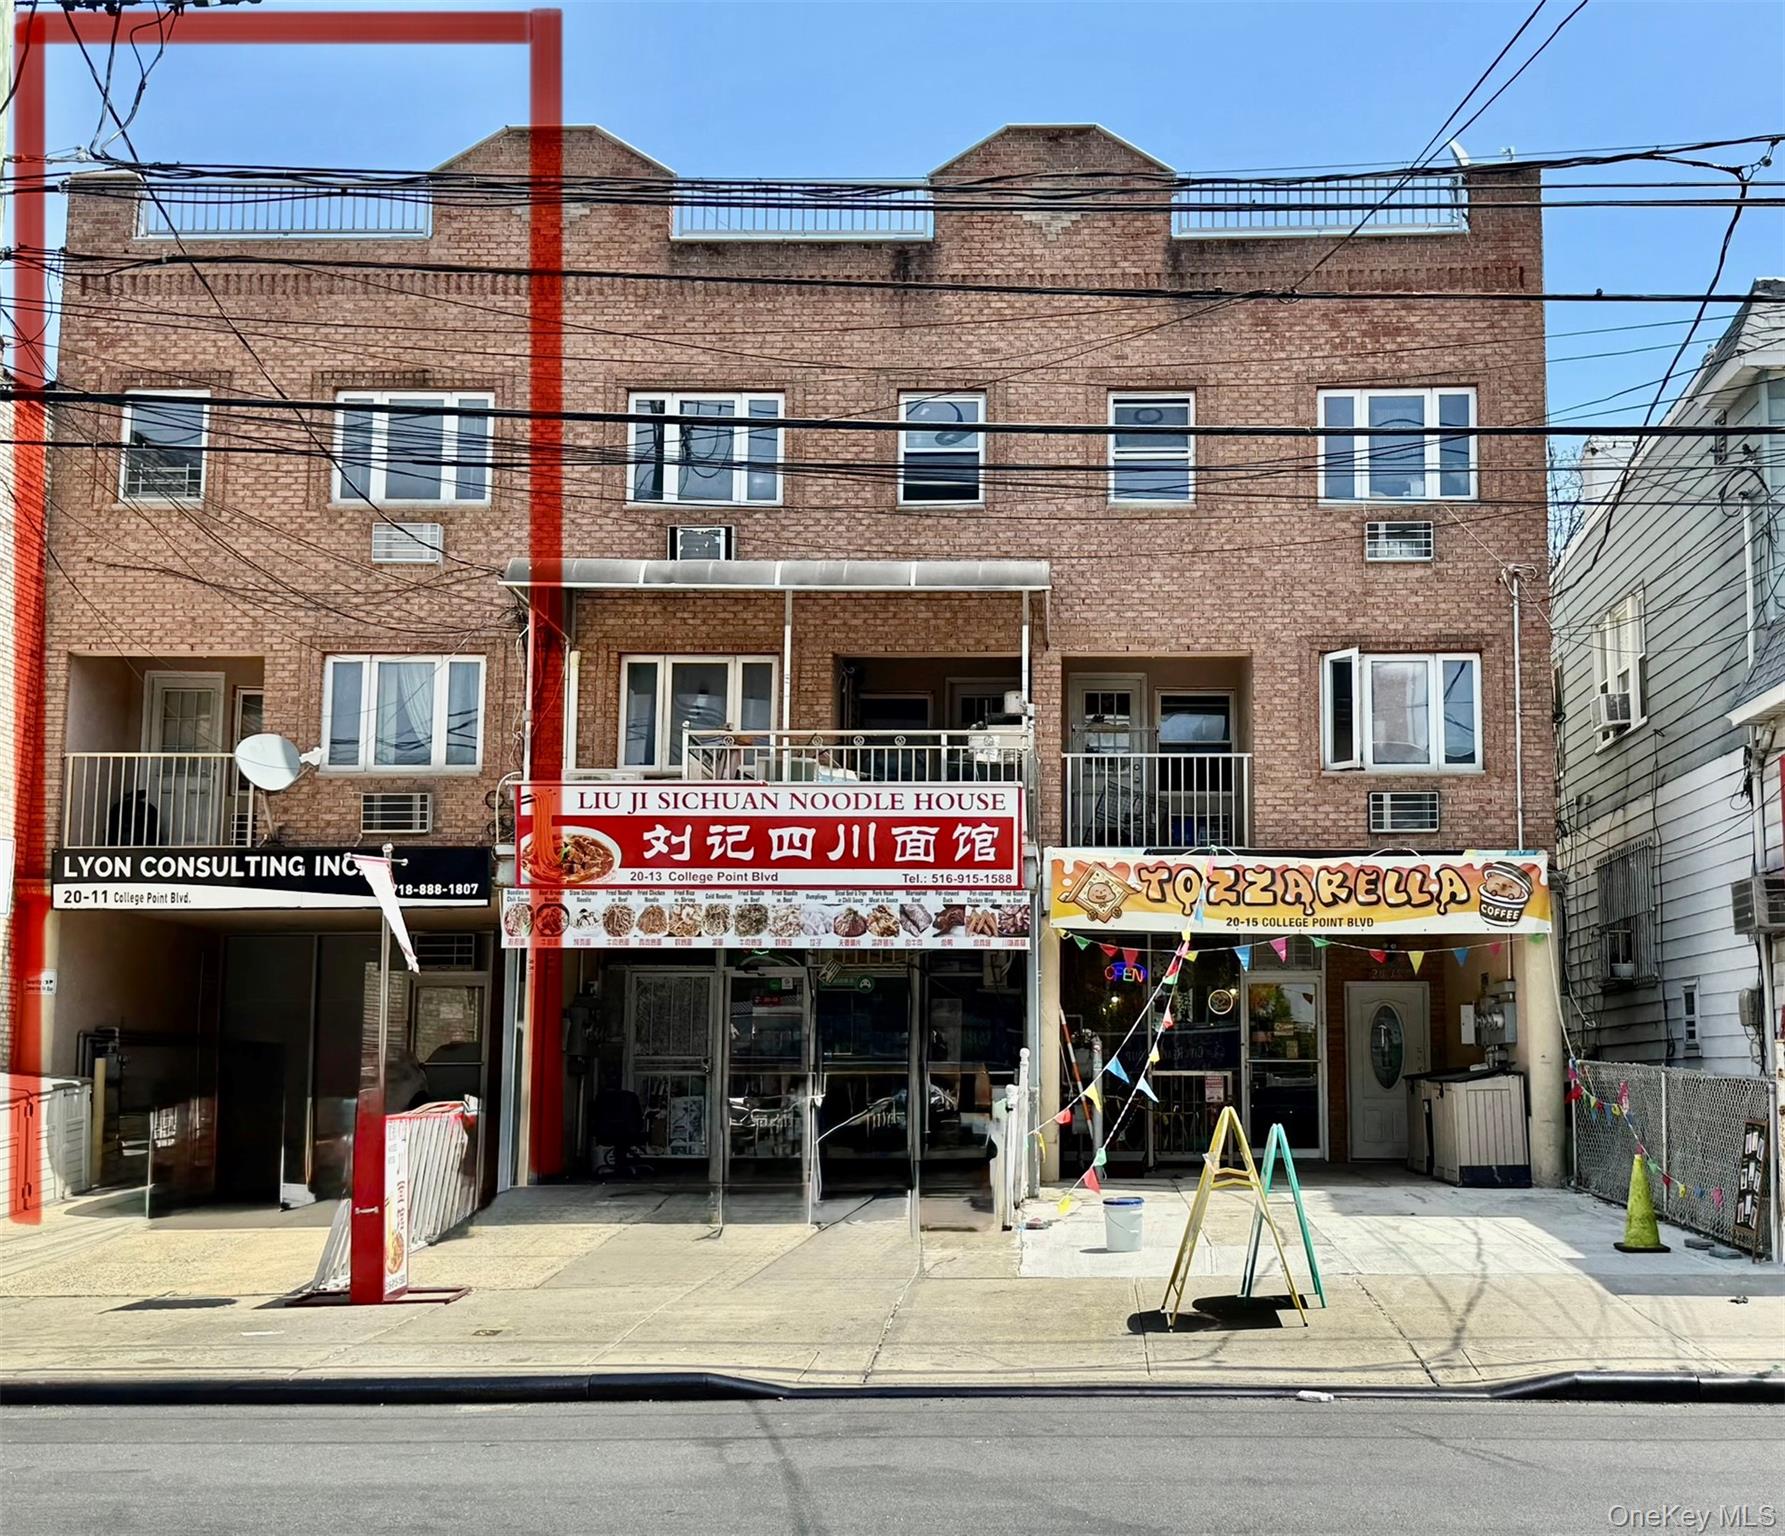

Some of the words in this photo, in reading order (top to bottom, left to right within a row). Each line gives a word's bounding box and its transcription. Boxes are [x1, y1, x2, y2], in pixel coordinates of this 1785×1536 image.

[578, 791, 621, 809] LIU
[627, 791, 648, 814] JI
[658, 791, 779, 810] SICHUAN
[789, 792, 904, 810] NOODLE
[914, 793, 1006, 810] HOUSE
[643, 822, 999, 861] 刘记四川面馆
[63, 856, 131, 878] LYON
[140, 856, 305, 878] CONSULTING
[630, 871, 662, 882] 20-13
[669, 871, 713, 884] College
[717, 871, 748, 882] Point
[752, 871, 778, 882] Blvd
[902, 873, 927, 884] Tel.:
[931, 873, 1013, 884] 516-915-1588
[64, 890, 108, 904] 20-11
[114, 891, 145, 905] College
[147, 891, 168, 904] Point
[170, 891, 191, 904] Blvd.
[1138, 866, 1470, 916] TOZZARELLA
[1481, 904, 1520, 919] COFFEE
[1226, 917, 1259, 928] 20-15
[1262, 917, 1309, 928] COLLEGE
[1312, 917, 1344, 928] POINT
[1347, 917, 1374, 928] BLVD
[1104, 965, 1143, 982] OPEN
